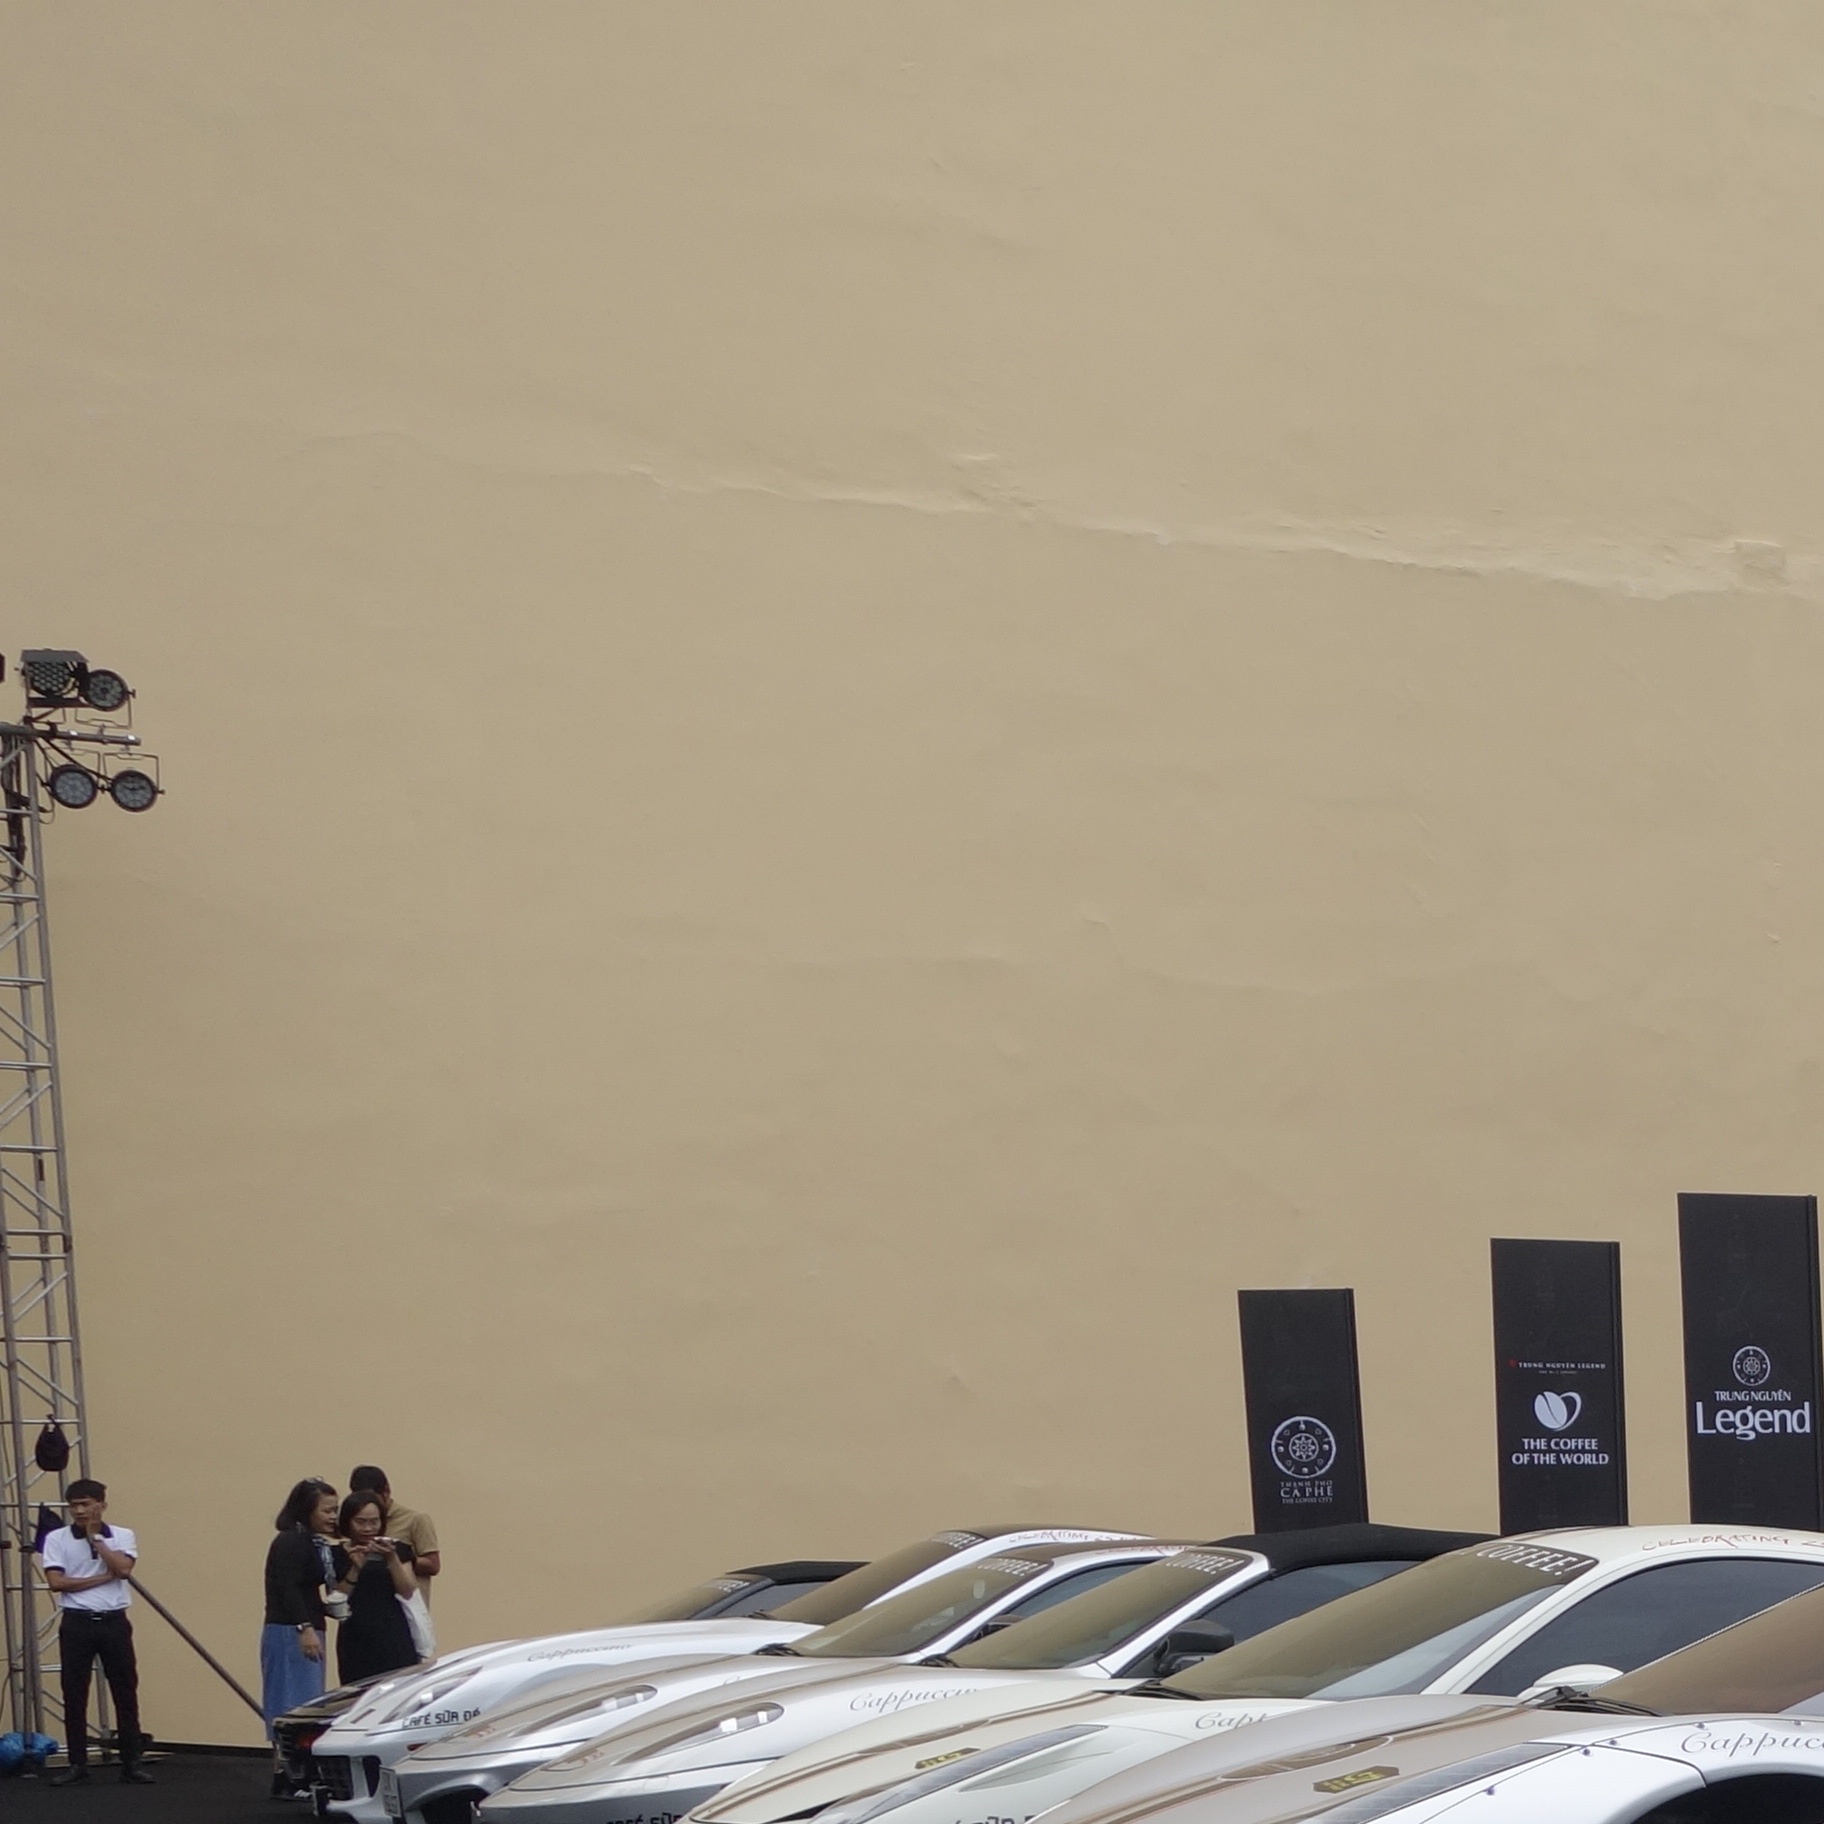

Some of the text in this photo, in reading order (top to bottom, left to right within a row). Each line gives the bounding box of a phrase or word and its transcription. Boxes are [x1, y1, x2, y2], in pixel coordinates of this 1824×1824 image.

[1714, 1391, 1749, 1401] TRUNG
[1696, 1401, 1811, 1440] Legend
[1522, 1438, 1598, 1450] THE COFFEE
[1511, 1453, 1609, 1465] OF THE WORLD
[1641, 1532, 1790, 1552] CELEBRATING
